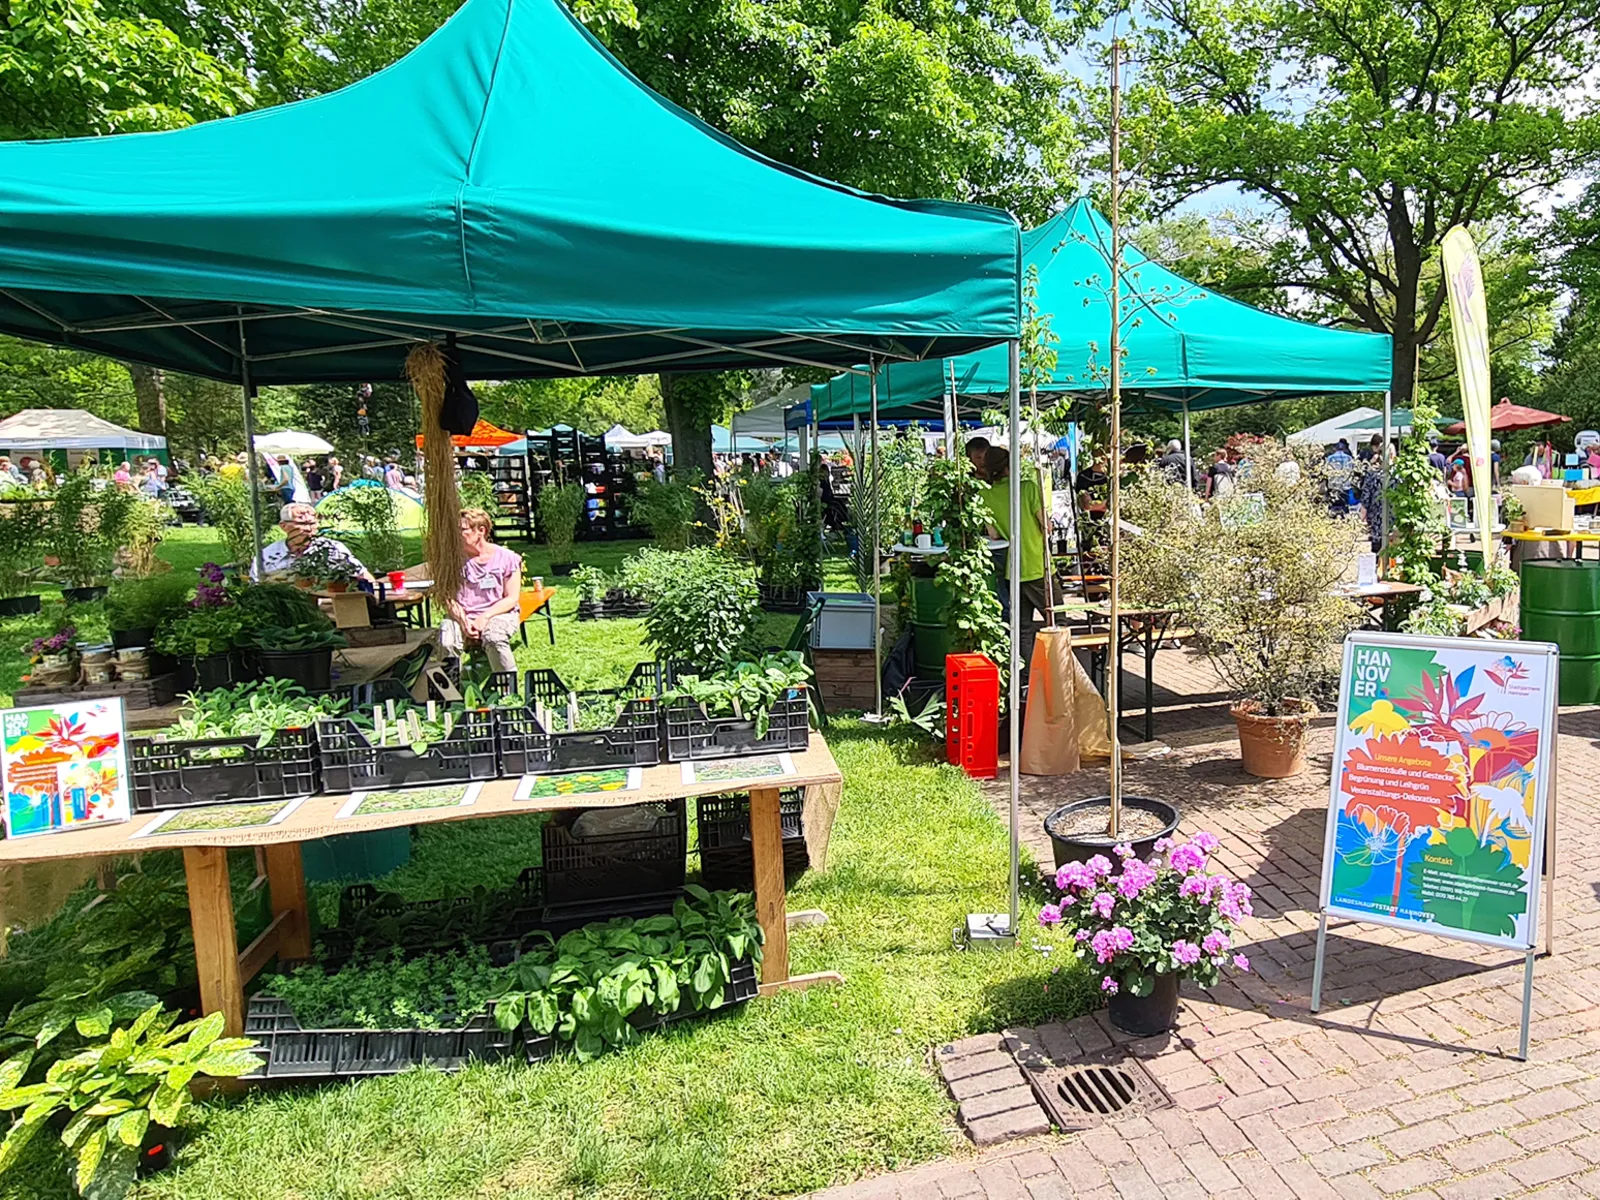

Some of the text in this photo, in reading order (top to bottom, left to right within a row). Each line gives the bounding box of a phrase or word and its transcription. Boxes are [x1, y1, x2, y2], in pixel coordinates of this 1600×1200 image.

[1357, 649, 1391, 667] HAN
[1356, 665, 1390, 683] NOV
[1354, 680, 1377, 698] ER
[1374, 753, 1432, 767] Unsere Angebote
[1356, 763, 1454, 781] Blumensträuße und Gestecke
[1348, 773, 1430, 790] Begrünung und Leihgrün
[1350, 785, 1441, 804] Veranstaltungs-Dekoration
[1424, 854, 1453, 866] Kontakt
[1334, 896, 1435, 919] LANDESHAUPTSTADT HANNOVER
